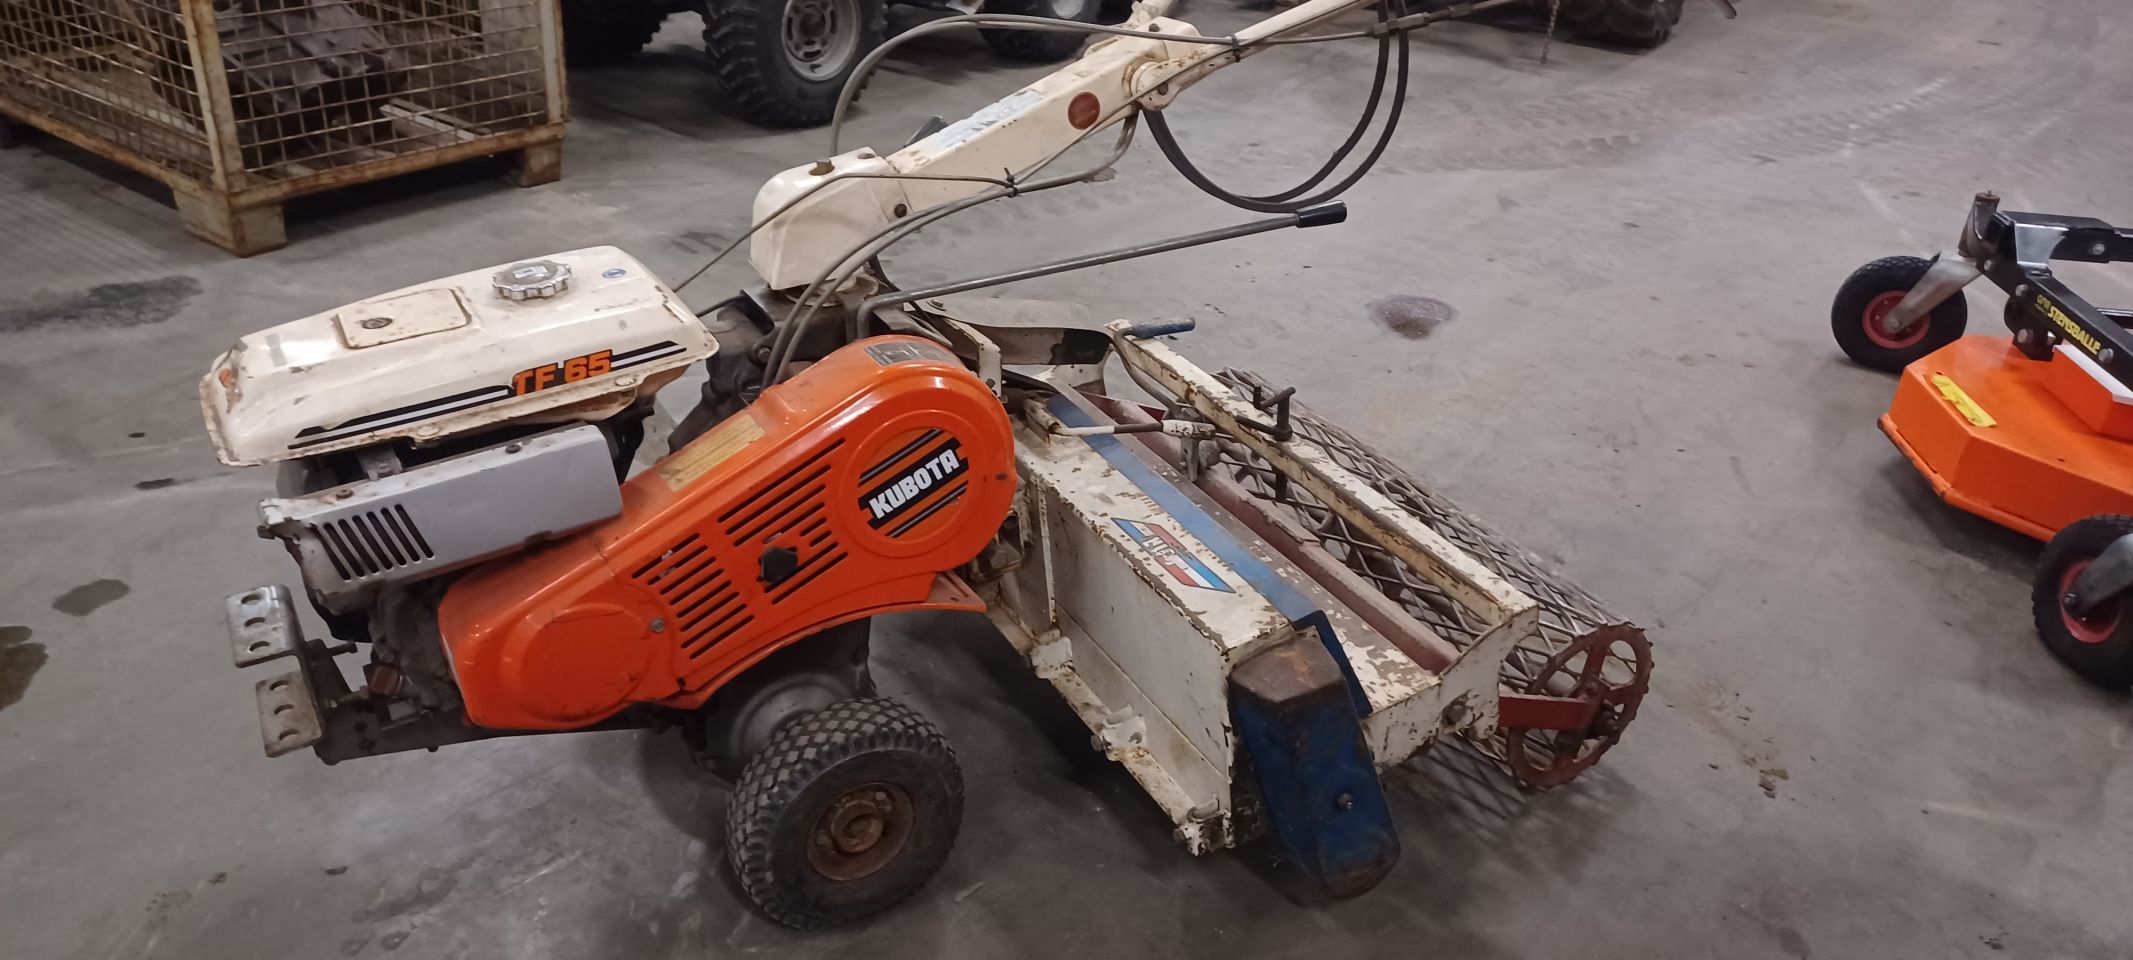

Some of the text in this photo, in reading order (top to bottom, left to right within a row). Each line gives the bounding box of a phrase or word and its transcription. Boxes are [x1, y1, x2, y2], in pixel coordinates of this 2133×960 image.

[2047, 305, 2101, 355] STENSBALLE
[513, 349, 612, 396] TF 65
[868, 448, 960, 519] KUBOTA
